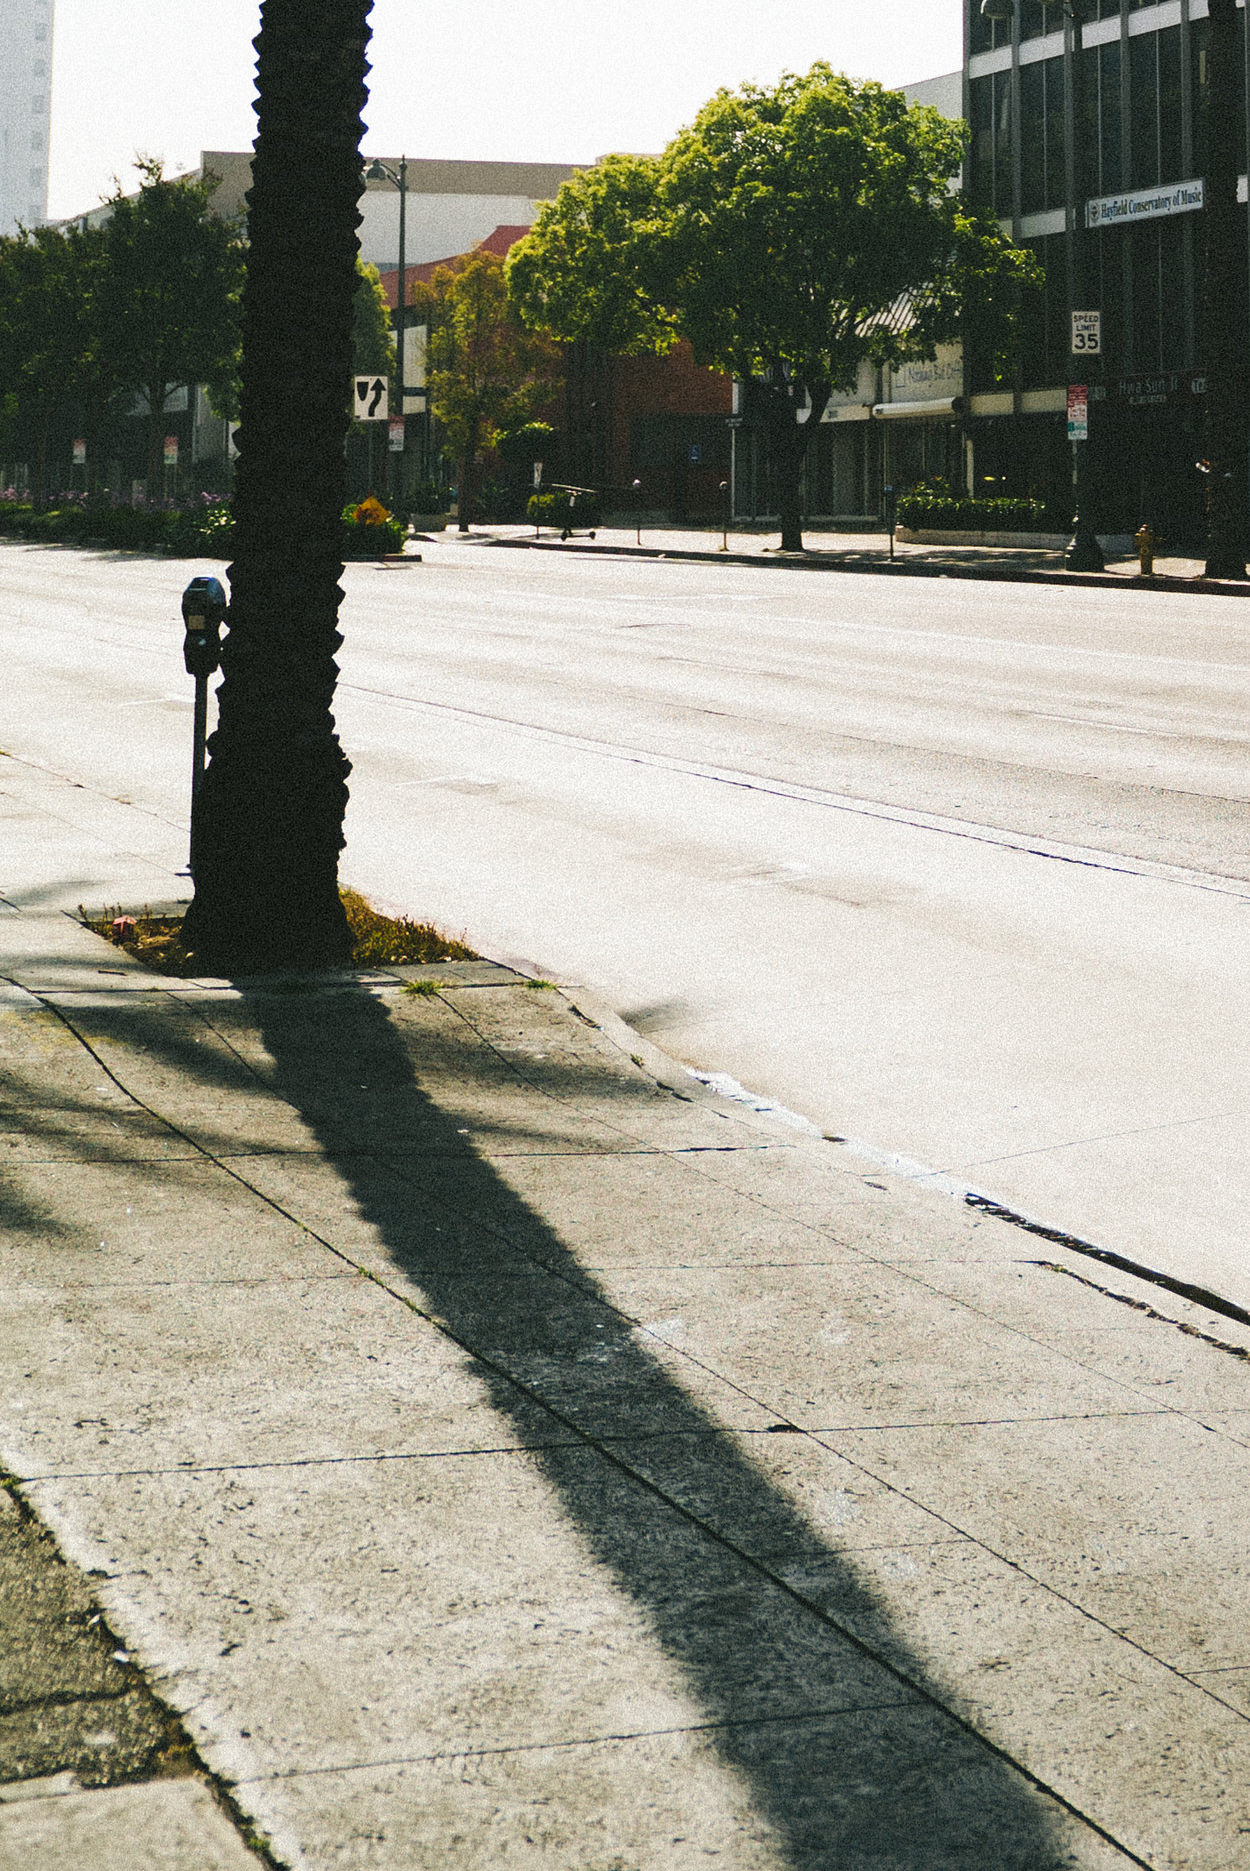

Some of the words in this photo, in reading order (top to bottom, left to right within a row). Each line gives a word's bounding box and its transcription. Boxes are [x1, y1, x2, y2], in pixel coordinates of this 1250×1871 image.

[1129, 195, 1172, 214] Conservatory
[1173, 189, 1181, 206] of
[1181, 186, 1202, 205] Music
[1076, 324, 1096, 332] LIMIT
[1074, 333, 1099, 350] 35
